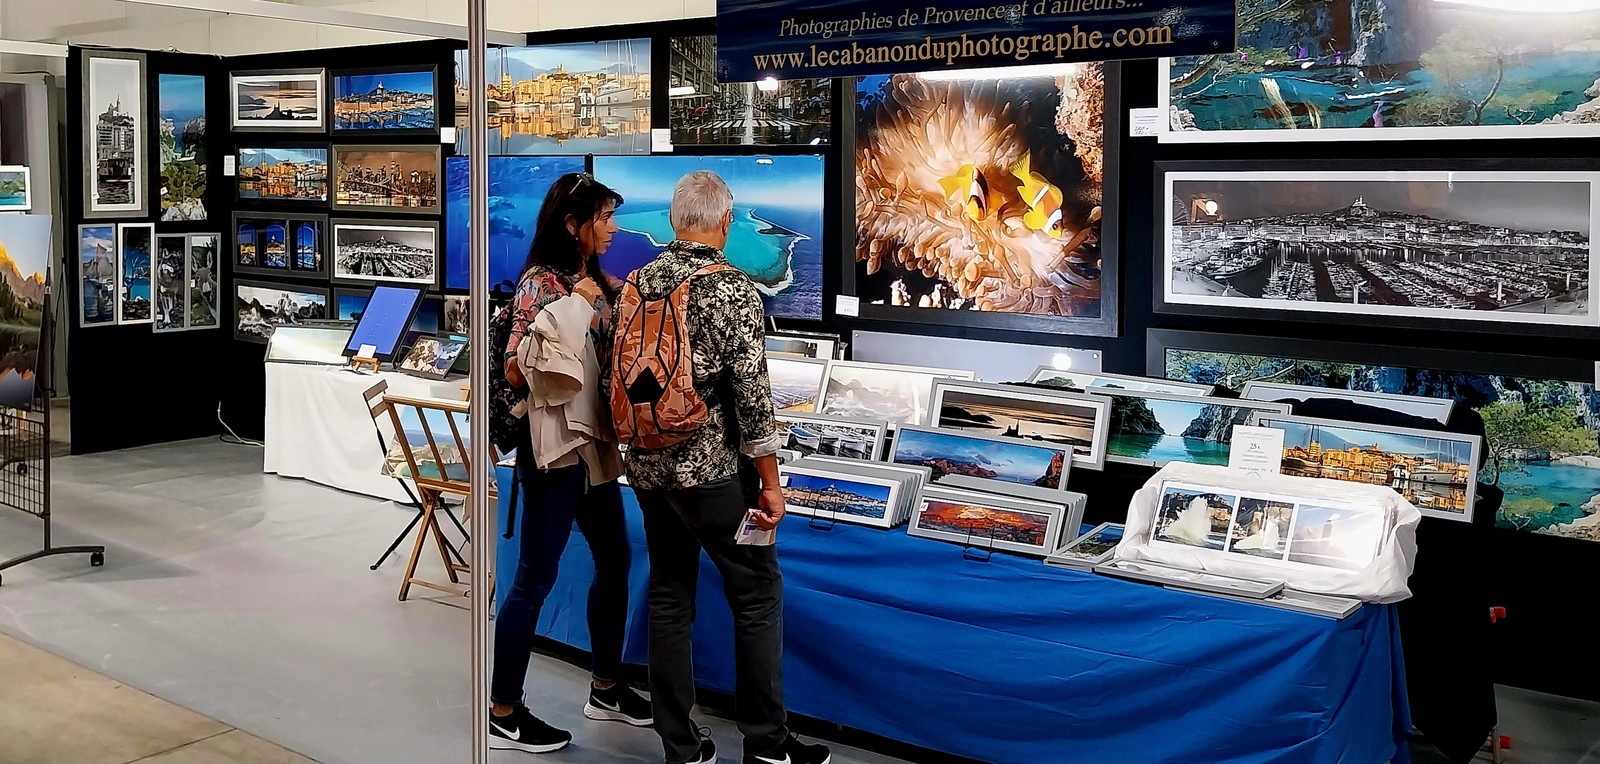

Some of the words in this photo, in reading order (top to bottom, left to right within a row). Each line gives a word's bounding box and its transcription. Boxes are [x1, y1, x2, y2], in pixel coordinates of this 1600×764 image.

[778, 11, 893, 39] Photographies
[897, 9, 918, 27] de
[922, 6, 1005, 25] Provence
[1009, 2, 1029, 17] et
[753, 24, 1174, 71] www.lecabanonduphotographe.com
